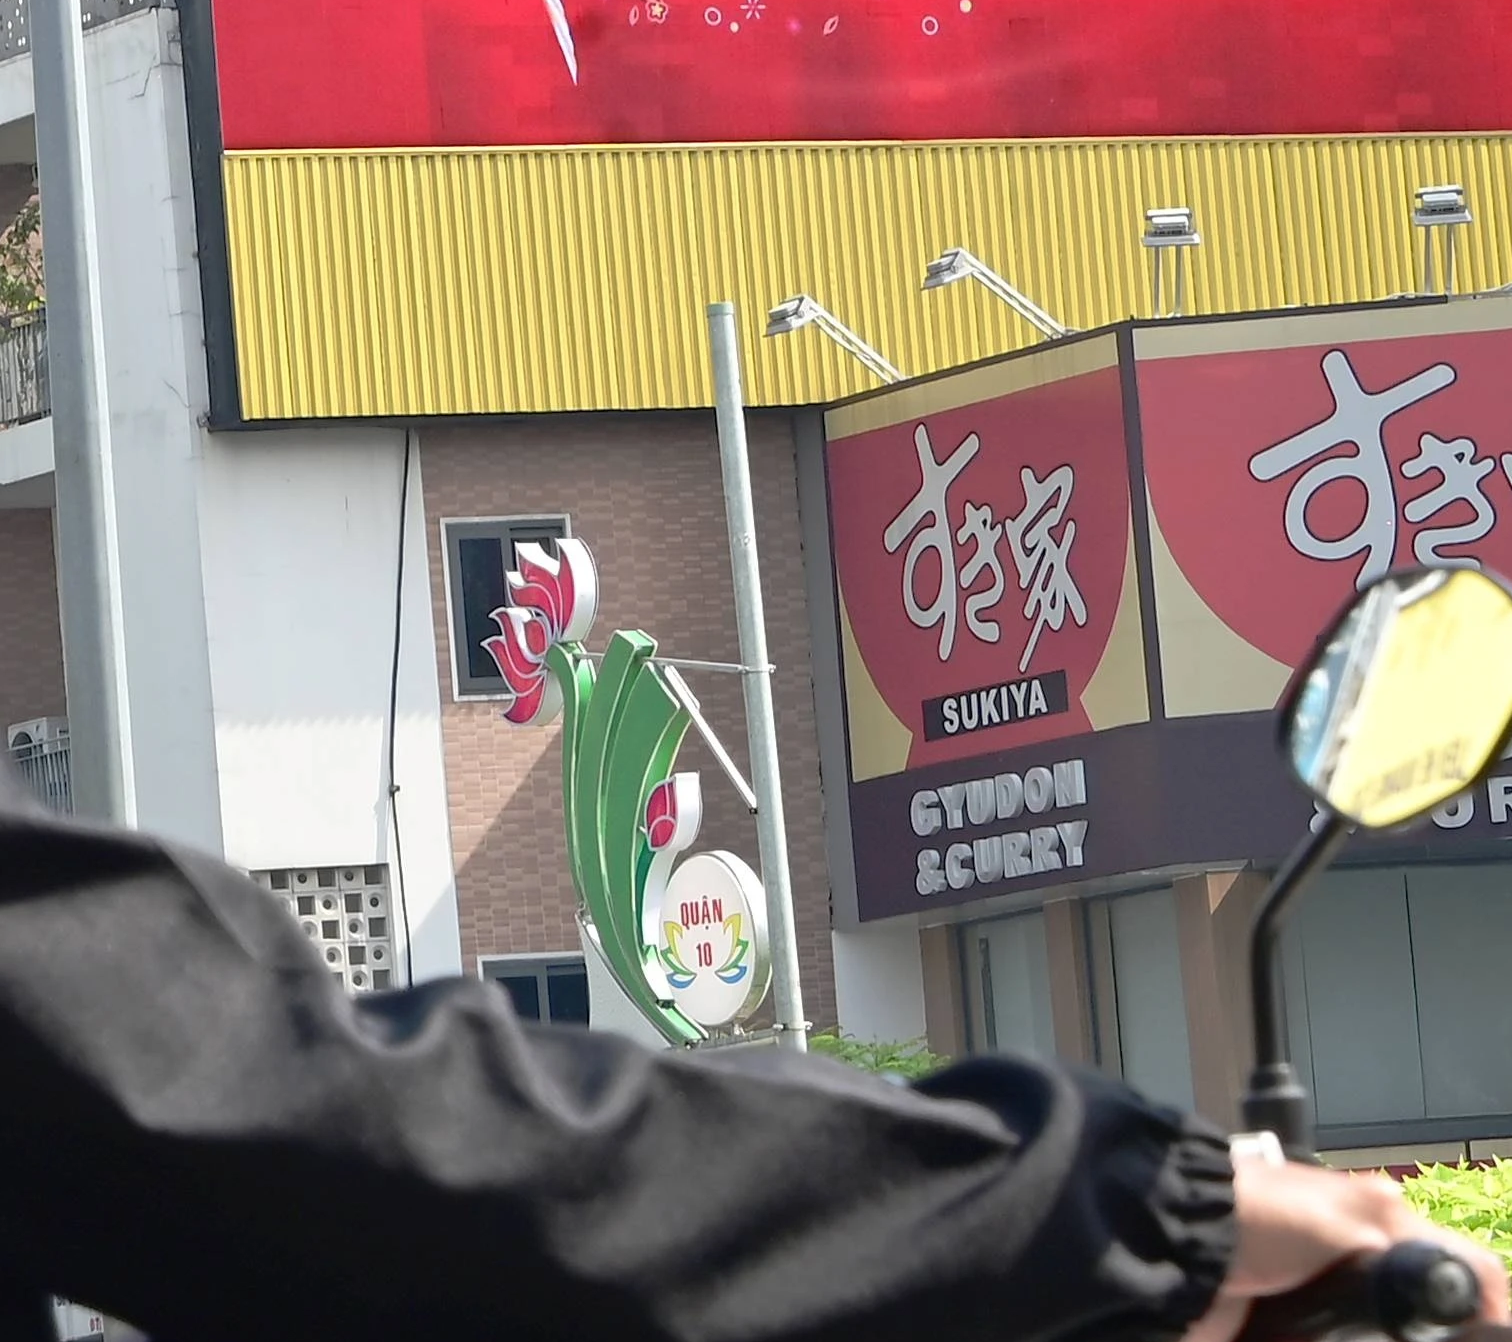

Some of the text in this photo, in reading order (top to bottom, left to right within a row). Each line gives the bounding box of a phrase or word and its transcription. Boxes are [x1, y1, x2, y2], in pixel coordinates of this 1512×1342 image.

[883, 422, 1088, 673] すき家
[942, 679, 1049, 734] SUKIYA
[910, 759, 1087, 836] GYUDON
[680, 895, 723, 930] QUẬN
[696, 942, 712, 967] 10
